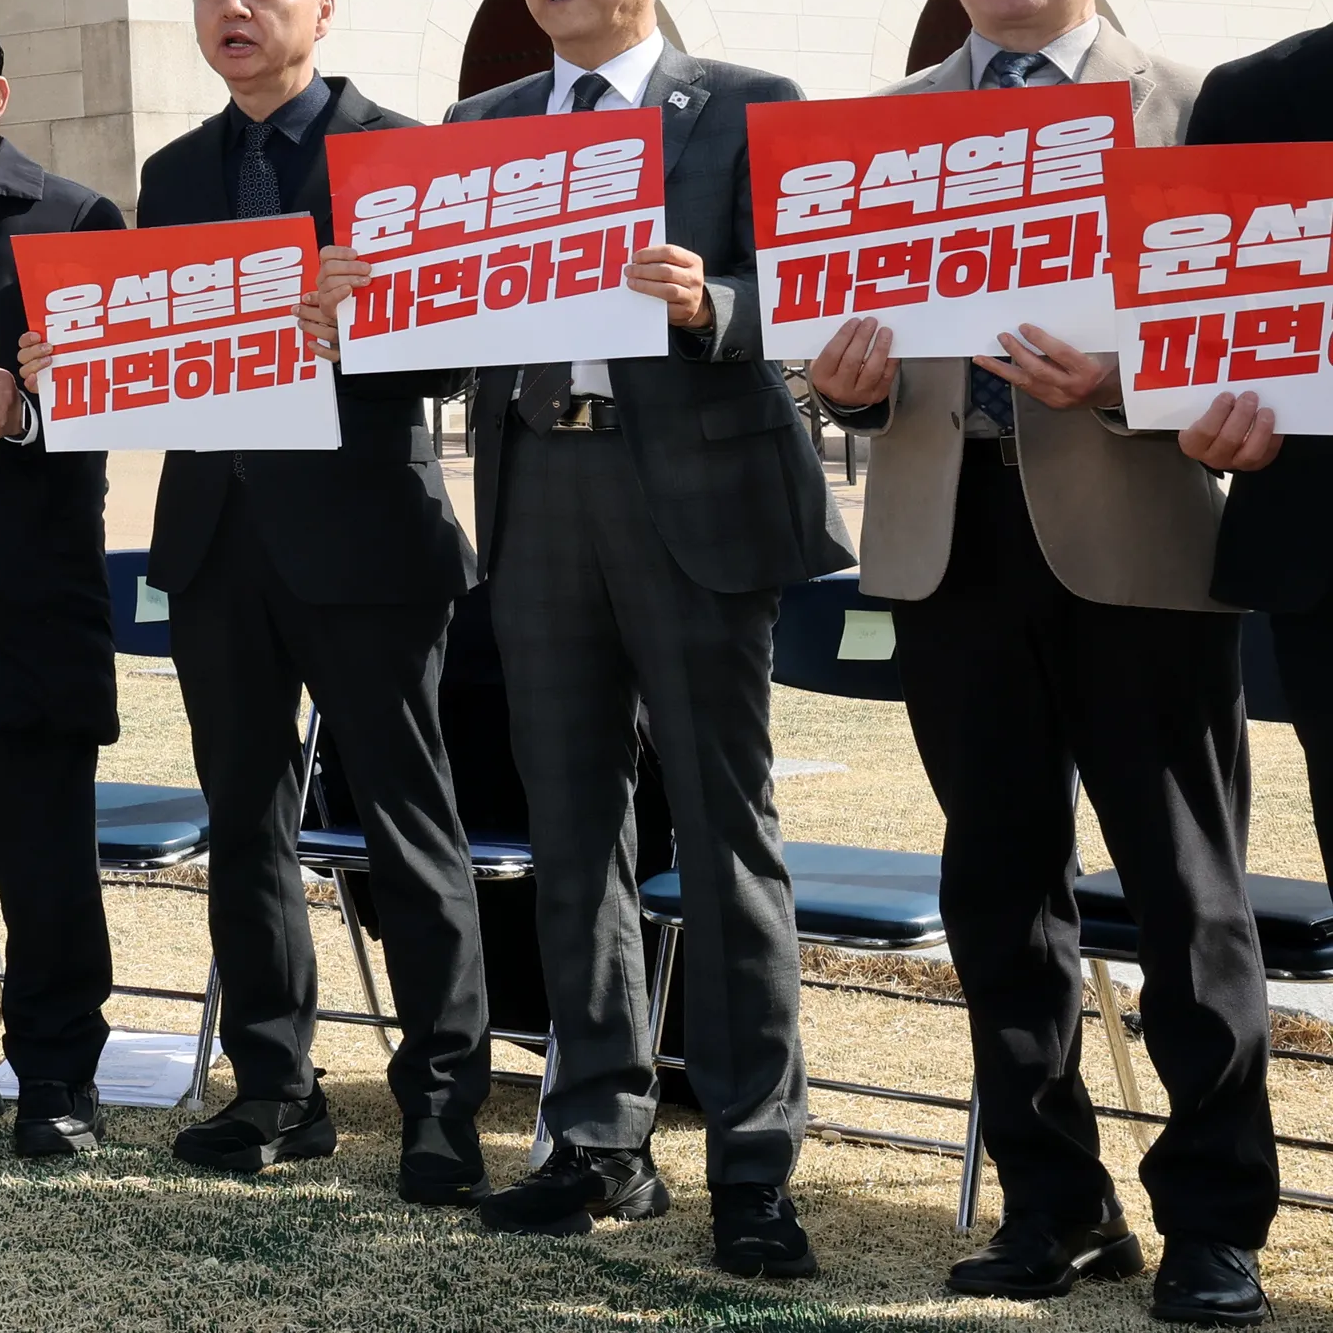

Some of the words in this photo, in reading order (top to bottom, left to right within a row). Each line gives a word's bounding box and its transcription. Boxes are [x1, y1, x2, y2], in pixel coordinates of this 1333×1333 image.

[351, 138, 645, 256] 윤석열을
[775, 115, 1115, 236] 윤석열을
[44, 246, 303, 346] 윤석열을
[771, 211, 1111, 325] 파면하라
[1137, 198, 1333, 295] 윤석
[50, 327, 318, 421] 파면하라!
[1134, 301, 1333, 392] 파면
